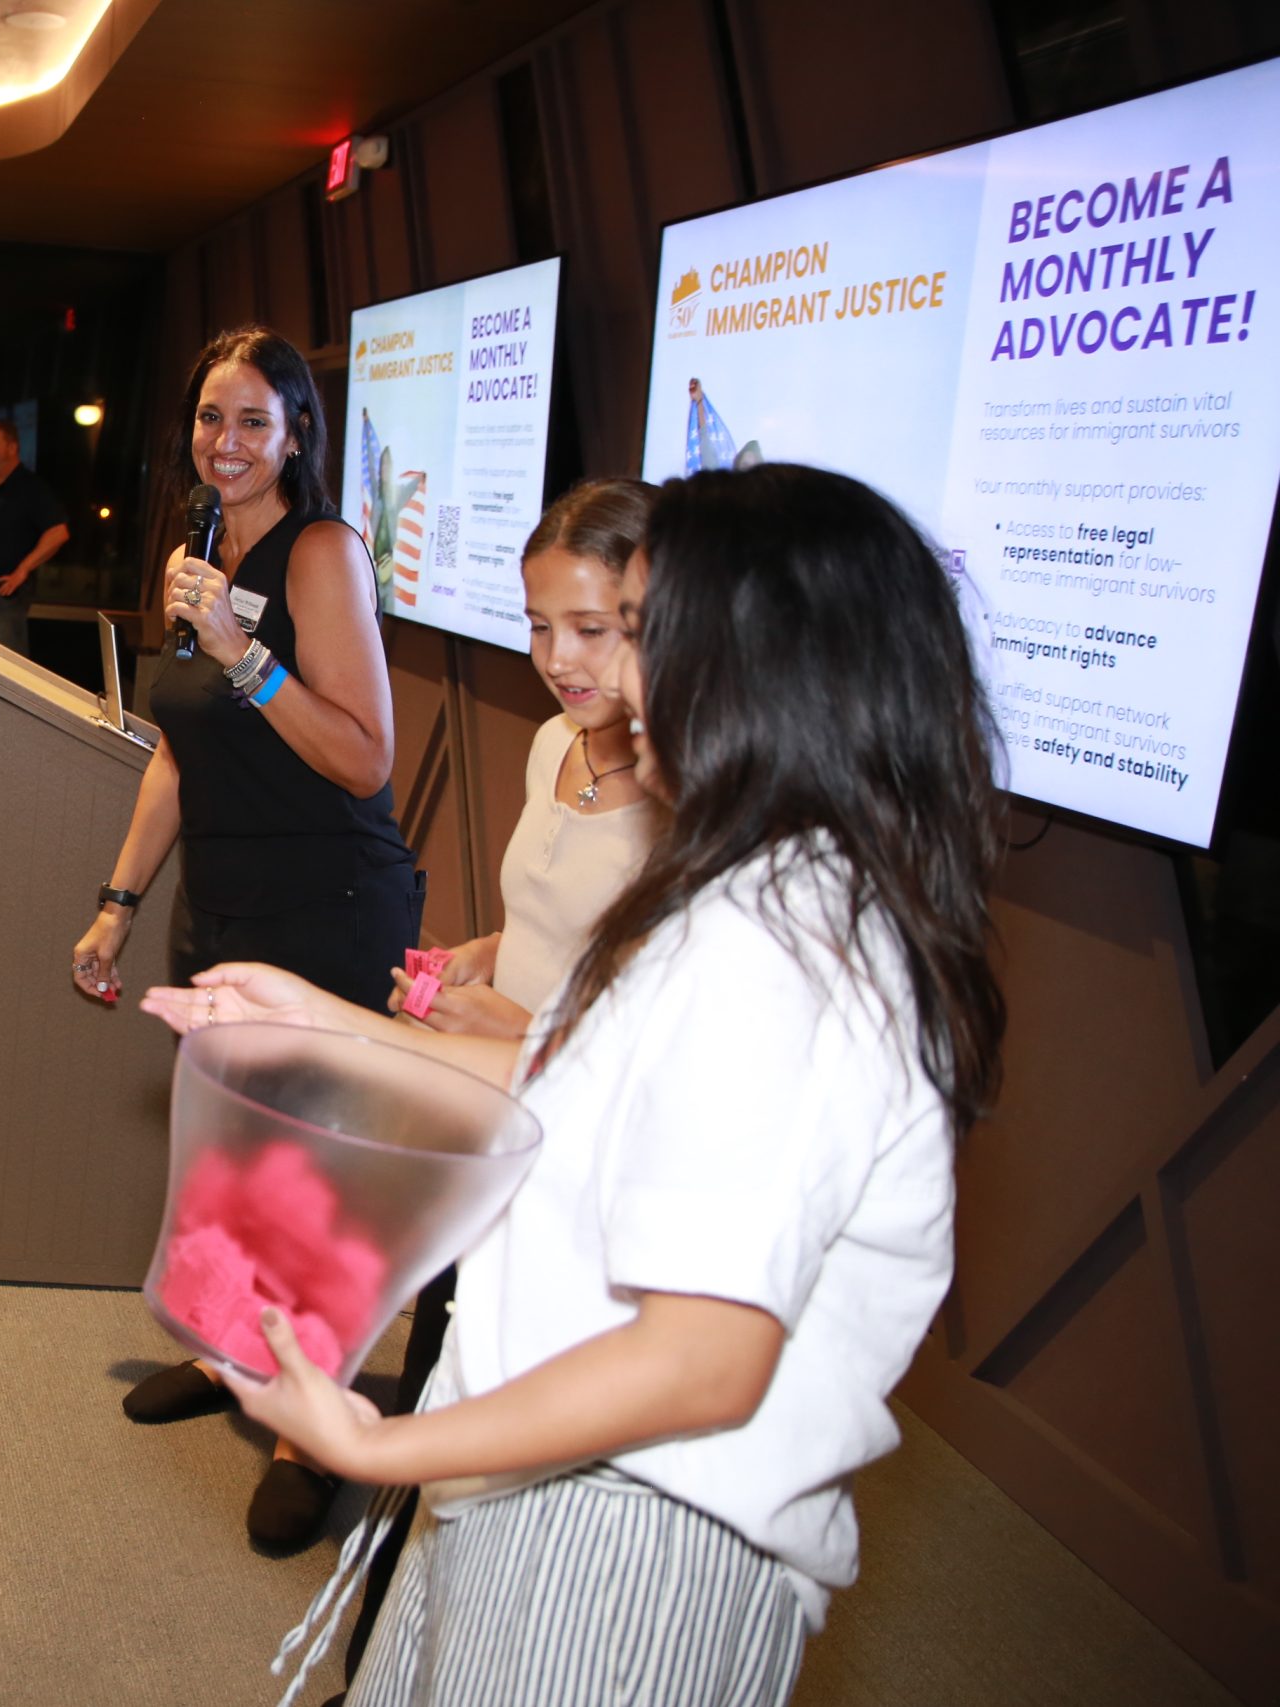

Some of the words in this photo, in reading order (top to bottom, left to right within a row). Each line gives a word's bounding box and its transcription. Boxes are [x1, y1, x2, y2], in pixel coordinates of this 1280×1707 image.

[1008, 165, 1191, 244] BECOME
[1197, 156, 1233, 210] A
[710, 241, 829, 293] CHAMPION
[1000, 228, 1215, 303] MONTHLY
[471, 307, 520, 339] BECOME
[522, 306, 531, 330] A
[705, 290, 832, 337] IMMIGRANT
[834, 271, 947, 320] JUSTICE
[370, 330, 415, 355] CHAMPION
[991, 290, 1257, 362] ADVOCATE!
[368, 358, 415, 382] IMMIGRANT
[416, 351, 454, 375] JUSTICE
[469, 341, 528, 371] MONTHLY
[466, 372, 538, 403] ADVOCATE!
[983, 400, 1052, 419] Transform
[1054, 398, 1087, 416] lives
[1091, 396, 1123, 415] and
[1126, 393, 1187, 414] sustain
[1193, 390, 1233, 411] vital
[980, 424, 1046, 441] resources
[1048, 422, 1069, 440] for
[1071, 421, 1156, 446] immigrant
[1160, 418, 1240, 439] survivors
[973, 477, 1003, 494] Your
[1004, 480, 1061, 502] monthly
[1064, 481, 1125, 503] support
[1127, 481, 1208, 504] provides:
[1006, 520, 1056, 538] Access
[1058, 524, 1073, 540] to
[1077, 523, 1108, 542] free
[1111, 525, 1154, 549] legal
[1003, 545, 1114, 568] representation
[1119, 550, 1140, 569] for
[1144, 553, 1183, 573] low-
[1000, 564, 1052, 586] income
[1055, 569, 1135, 597] immigrant
[1139, 580, 1216, 604] survivors
[993, 611, 1062, 638] Advocacy
[1065, 620, 1082, 639] to
[1084, 624, 1158, 649] advance
[991, 631, 1067, 659] immigrant
[1070, 644, 1117, 669] rights
[997, 682, 1043, 704] unified
[1045, 691, 1103, 716] support
[1105, 702, 1172, 730] network
[991, 703, 1030, 730] elping
[1033, 710, 1111, 741] immigrant
[1114, 731, 1187, 760] survivors
[1034, 738, 1081, 765] safety
[1083, 750, 1115, 769] and
[1117, 757, 1189, 792] stability
